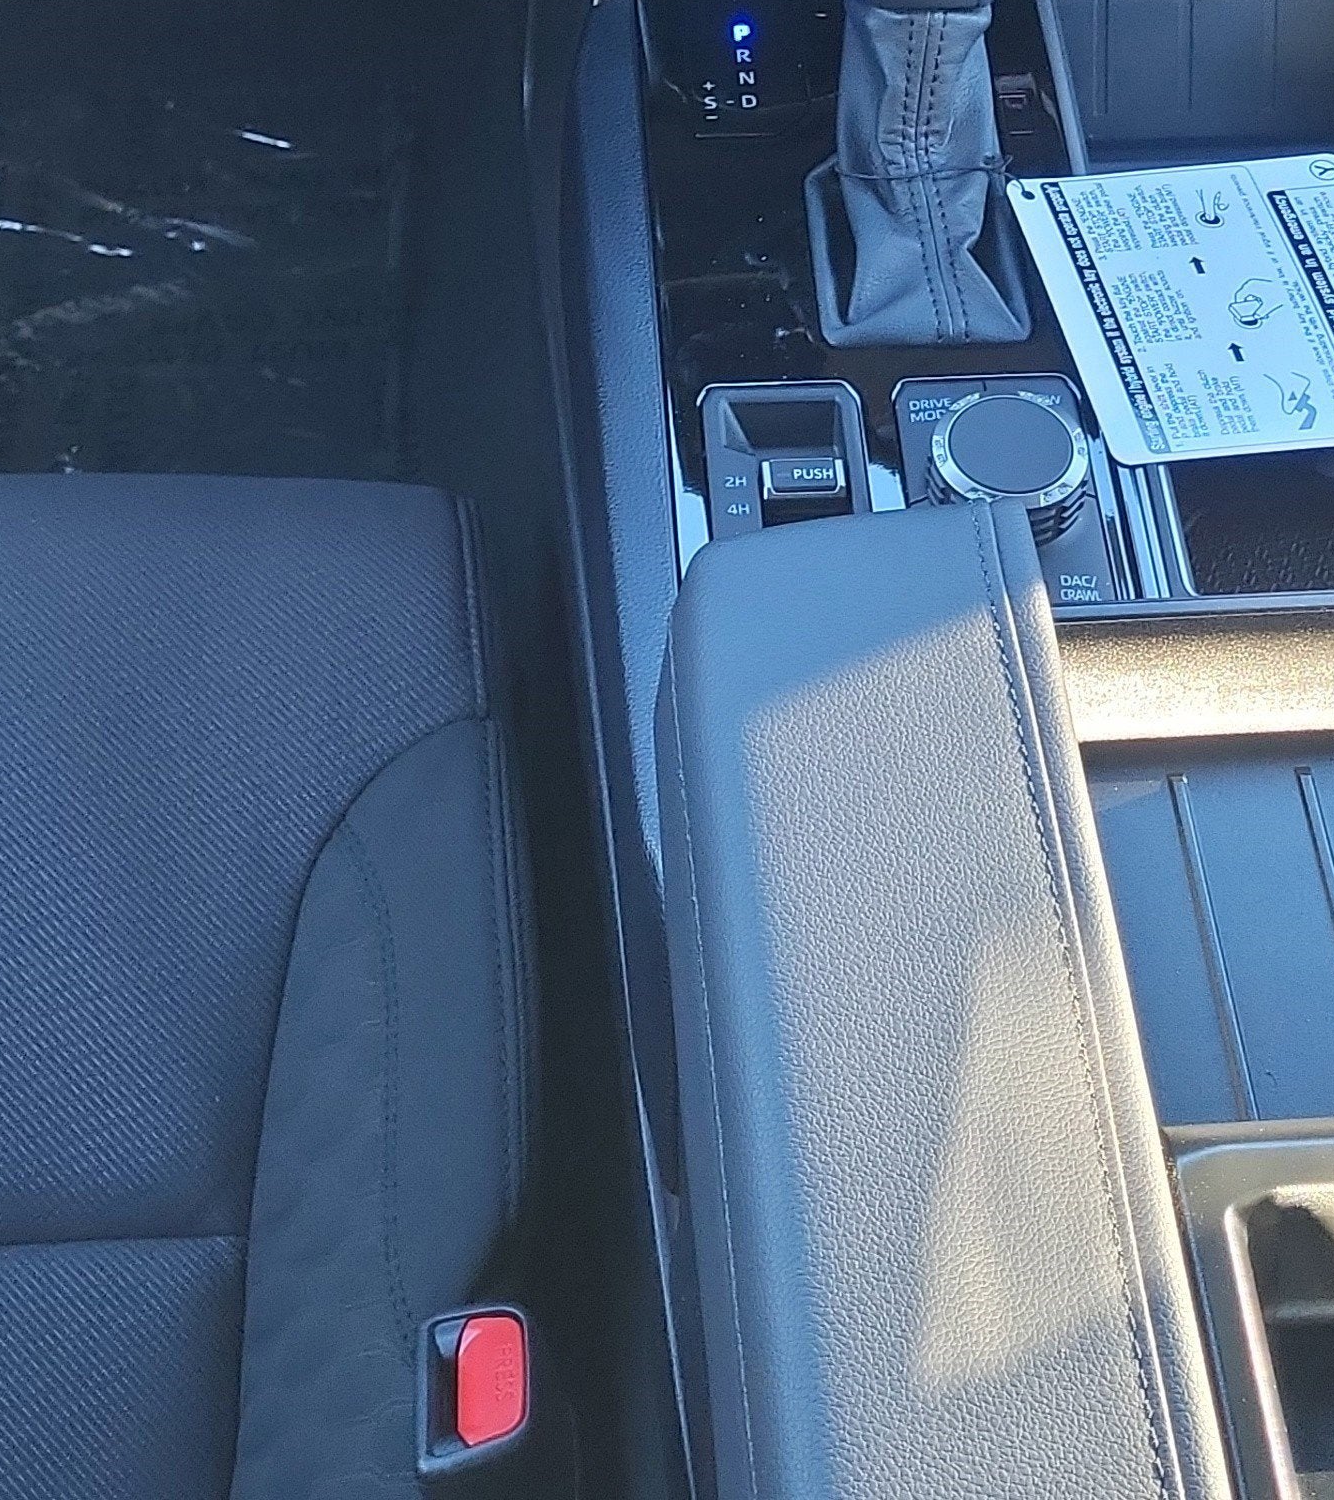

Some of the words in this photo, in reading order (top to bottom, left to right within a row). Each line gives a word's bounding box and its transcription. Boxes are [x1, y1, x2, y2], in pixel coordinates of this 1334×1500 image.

[733, 24, 751, 41] P
[736, 48, 752, 64] R
[739, 71, 755, 85] N
[742, 94, 757, 108] D
[1273, 194, 1303, 239] emergency
[1058, 213, 1077, 235] operate
[1067, 236, 1082, 248] not
[1298, 244, 1311, 254] an
[1075, 250, 1090, 266] does
[1083, 269, 1096, 281] key
[1312, 271, 1334, 303] system
[1087, 283, 1111, 315] electronic
[1103, 317, 1116, 329] the
[1112, 338, 1131, 363] system
[1120, 366, 1142, 389] hybrid
[908, 398, 952, 410] DRIVE
[1134, 394, 1152, 418] engine
[910, 409, 947, 423] MOD
[792, 468, 834, 480] PUSH
[725, 476, 747, 488] 2H
[727, 504, 750, 516] 4H
[1059, 575, 1097, 588] DAC/
[1059, 588, 1102, 602] CRAWL
